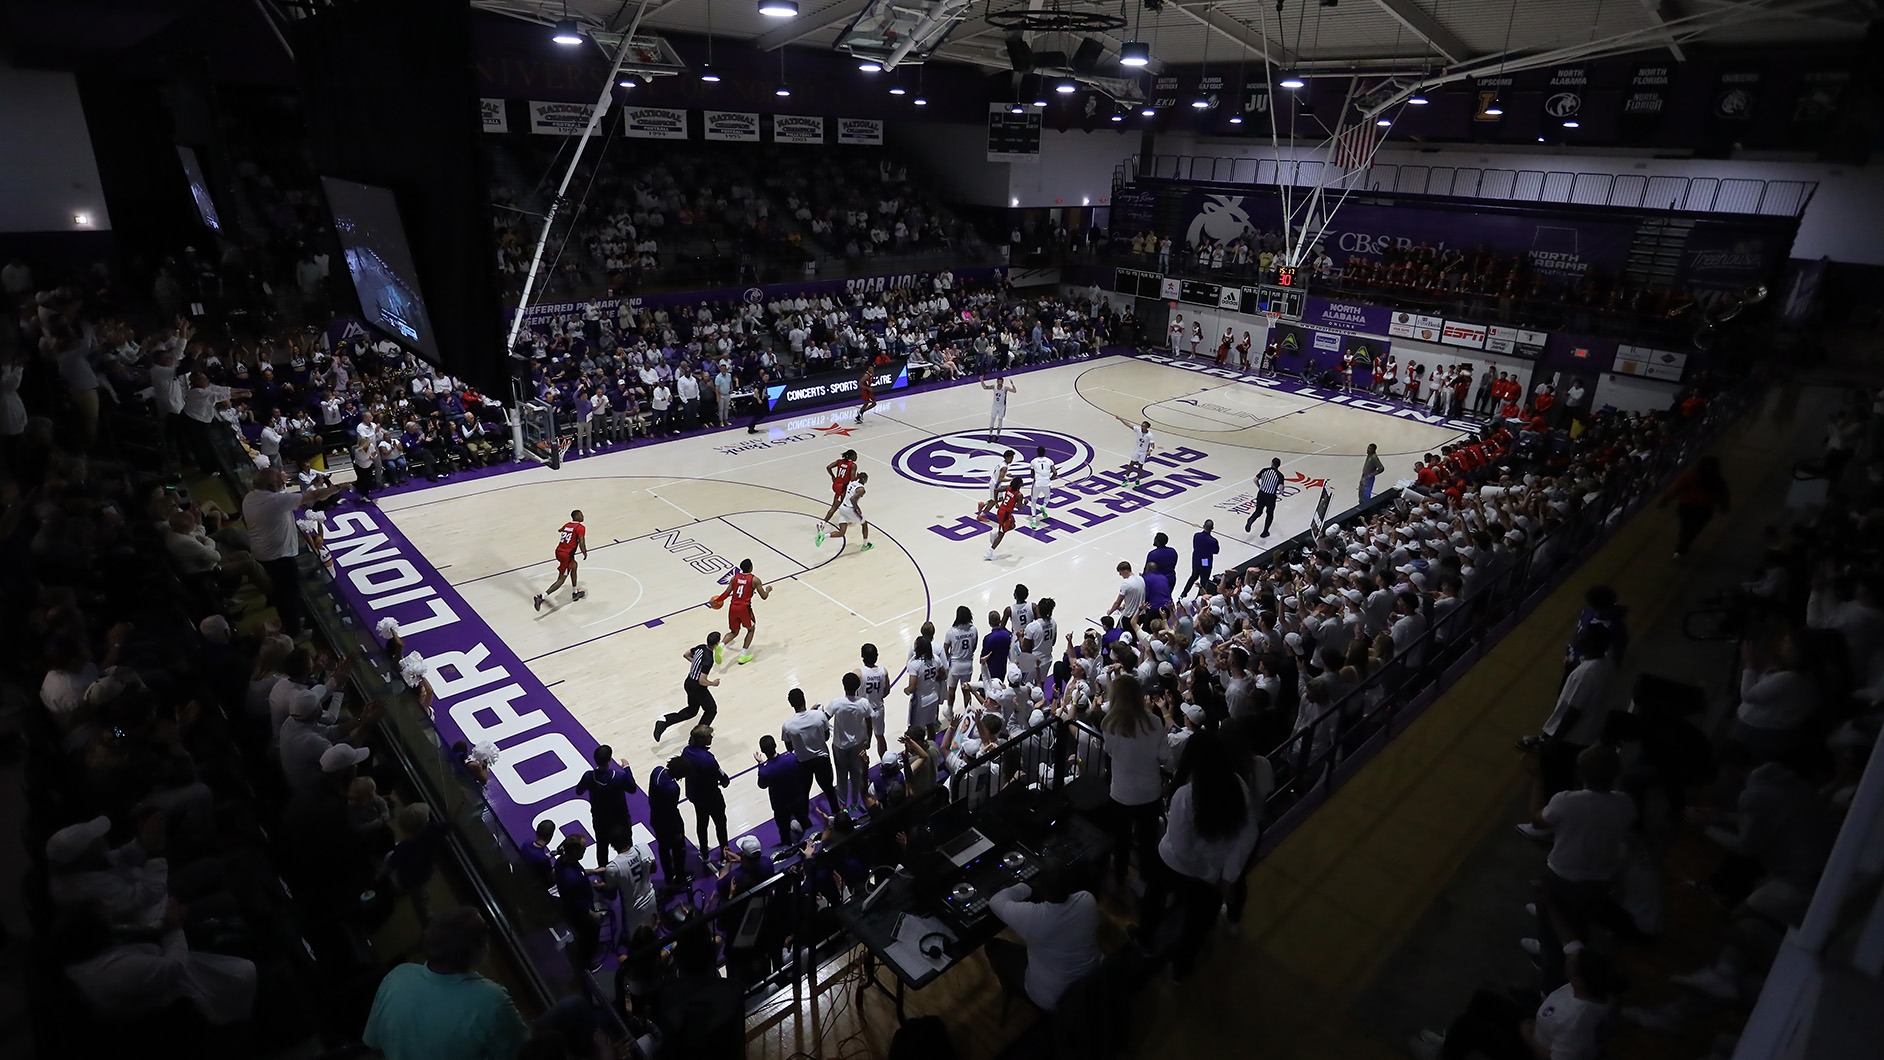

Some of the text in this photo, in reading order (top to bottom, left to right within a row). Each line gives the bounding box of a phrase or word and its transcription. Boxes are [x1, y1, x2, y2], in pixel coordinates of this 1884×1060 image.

[1558, 69, 1584, 78] NORTH
[1639, 67, 1667, 77] NORTH
[1477, 77, 1513, 87] LIPSCOMB
[1551, 77, 1587, 86] ALABAMA
[1633, 76, 1668, 86] FLORIDA
[1245, 93, 1269, 112] JU
[630, 109, 682, 123] NATIONAL
[709, 113, 755, 126] NATIONAL
[776, 118, 821, 130] NATIONAL
[841, 121, 879, 131] NATIONAL
[1339, 232, 1391, 256] CB&S
[1528, 250, 1580, 262] NORTH
[1534, 259, 1588, 271] ABAMA
[846, 276, 886, 294] ROAR
[1278, 273, 1291, 286] 30
[576, 299, 620, 311] PRMARY
[1221, 299, 1239, 307] adidas
[1330, 302, 1361, 315] NORTH
[1322, 310, 1366, 324] ALABAMA
[1328, 321, 1354, 329] ONLINE
[1444, 326, 1485, 342] ESPN
[787, 385, 826, 402] CONCERTS
[830, 380, 859, 395] SPORTS
[1134, 352, 1483, 434] ROAR LIONS
[721, 440, 771, 456] Bank
[839, 466, 848, 478] 14
[926, 446, 1207, 542] ALABAA
[1015, 466, 1222, 544] NORTH
[560, 532, 573, 545] 24
[321, 510, 462, 639] LIONS
[737, 585, 745, 599] 4
[1019, 614, 1027, 626] 9
[1044, 629, 1053, 641] 21
[962, 639, 969, 650] 8
[924, 669, 936, 681] 25
[866, 682, 881, 694] 24
[630, 865, 643, 882] 5
